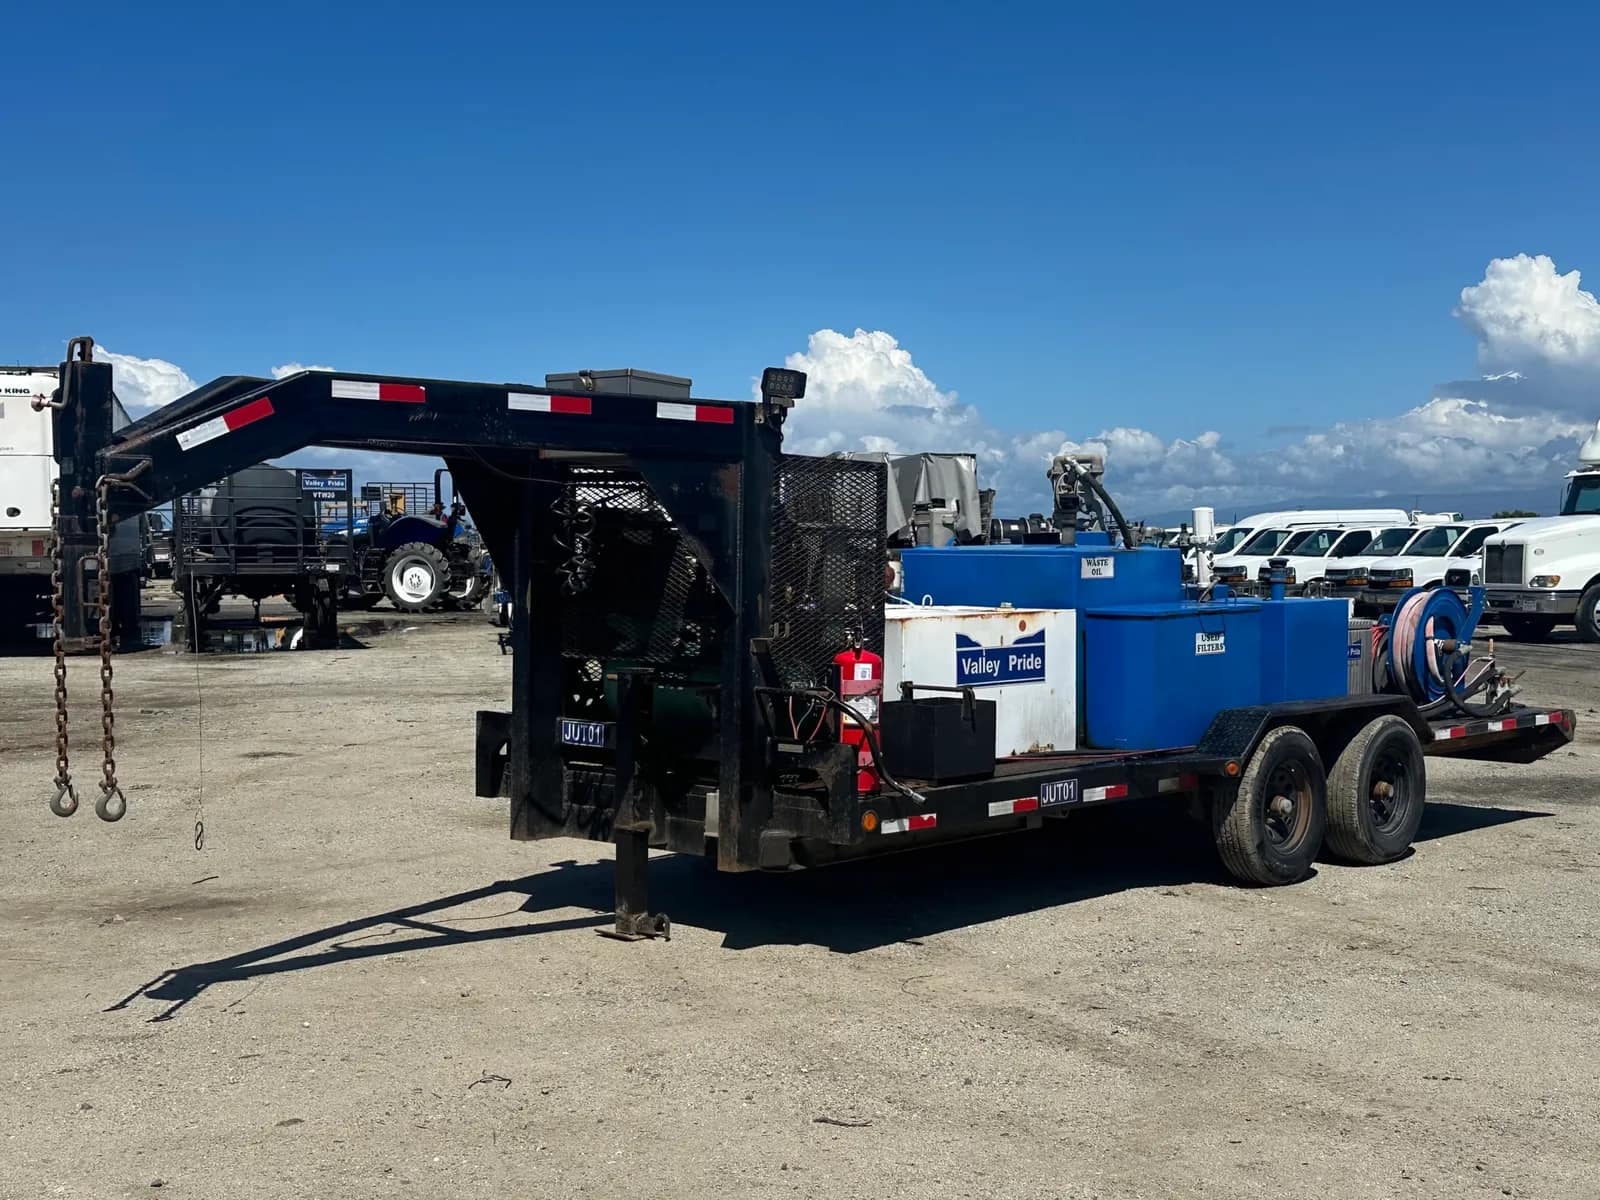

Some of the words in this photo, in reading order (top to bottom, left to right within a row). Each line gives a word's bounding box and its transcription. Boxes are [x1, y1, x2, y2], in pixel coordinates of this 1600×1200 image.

[1086, 558, 1109, 567] WASTE
[1091, 568, 1103, 576] OIL
[1202, 633, 1220, 641] USED
[1197, 642, 1224, 652] FILTERS
[962, 657, 1000, 677] Valley
[1008, 653, 1042, 671] Pride
[564, 723, 600, 744] JUT01
[1042, 781, 1074, 803] JUT01
